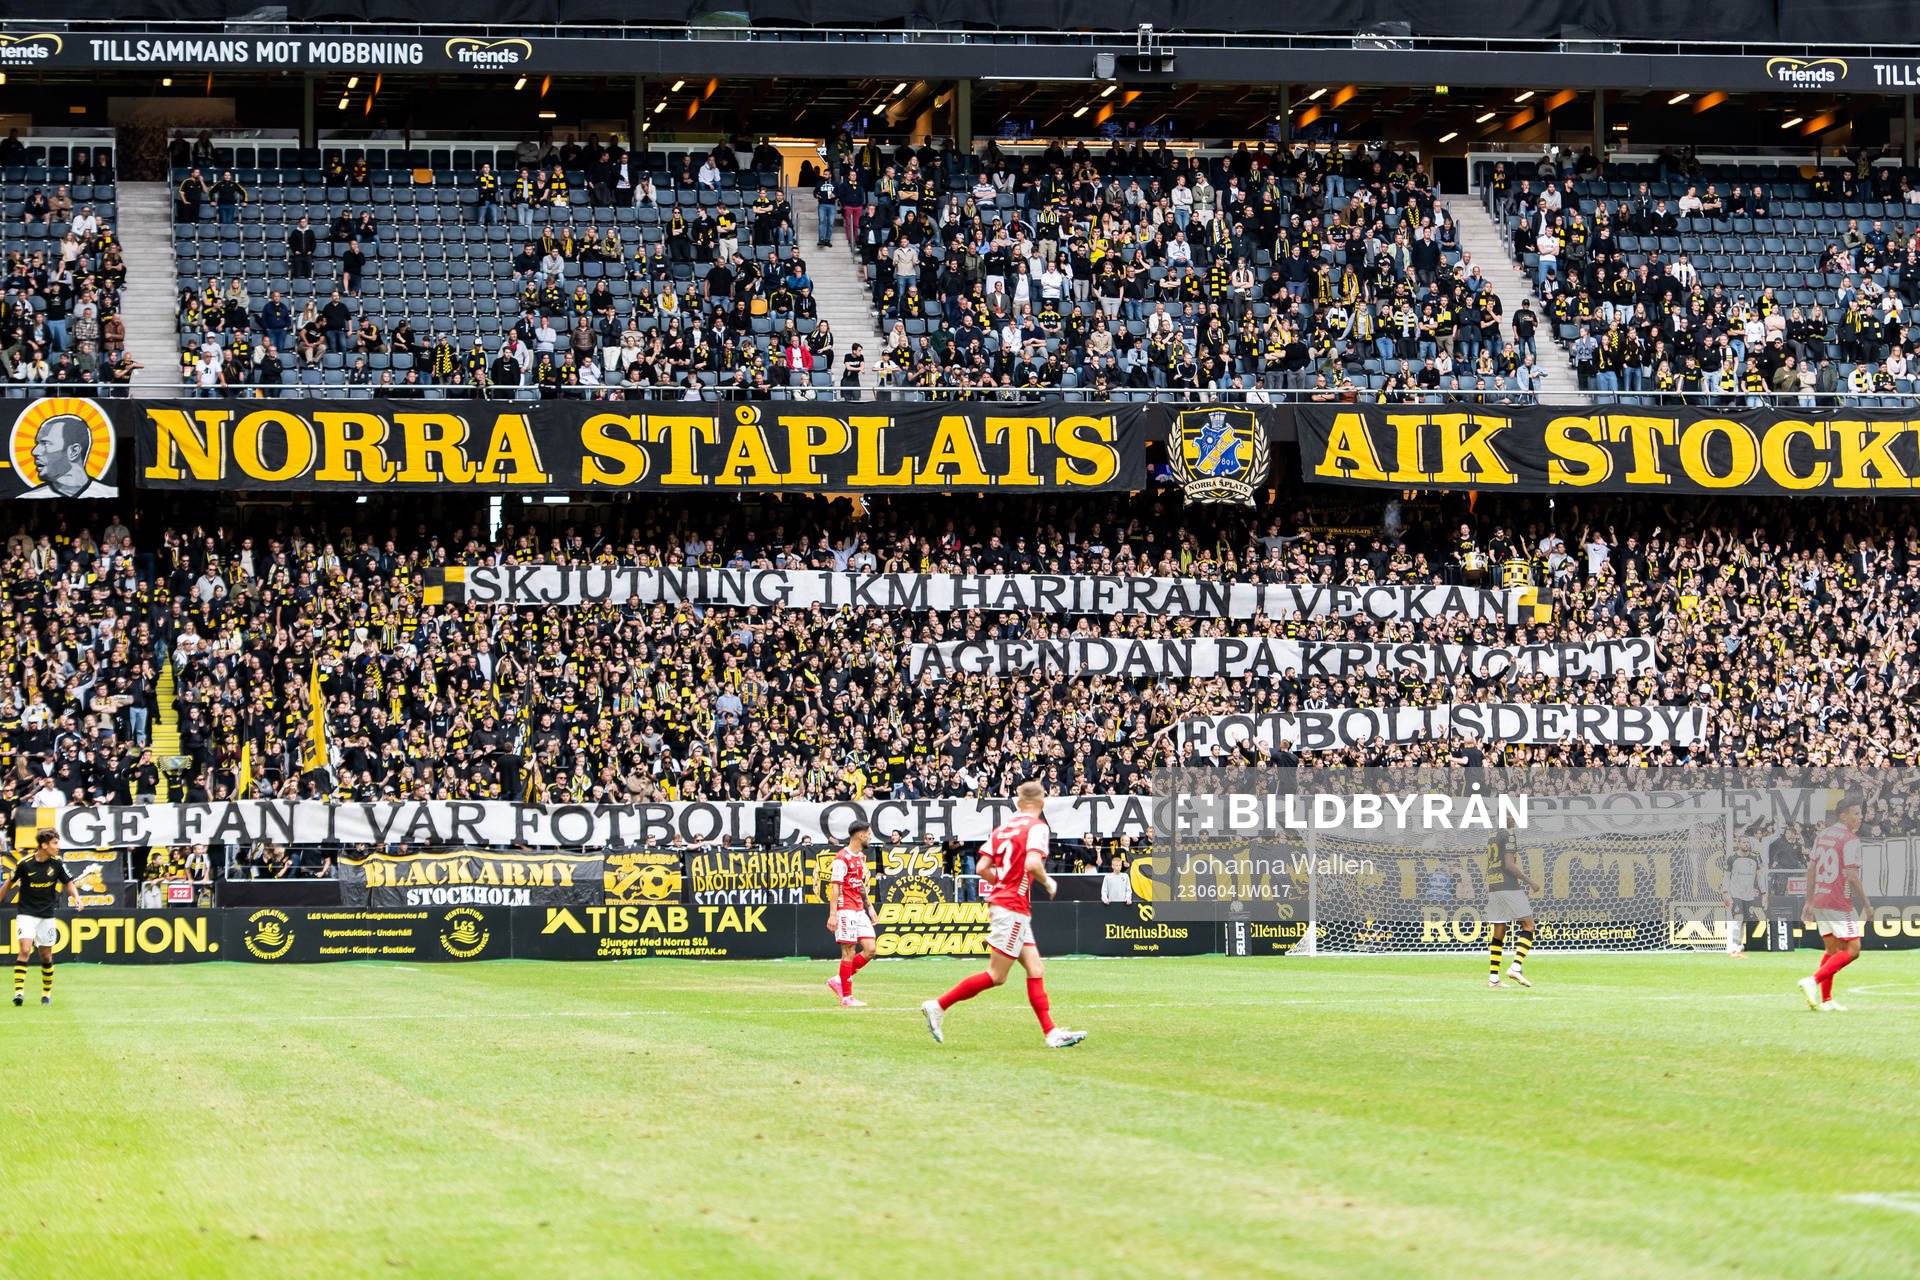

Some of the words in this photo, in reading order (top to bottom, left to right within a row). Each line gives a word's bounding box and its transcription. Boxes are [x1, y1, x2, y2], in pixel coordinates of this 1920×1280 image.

[89, 40, 249, 64] TILLSAMMANS
[256, 41, 301, 64] MOT
[308, 41, 423, 65] MOBBNING
[457, 46, 519, 64] friends
[1777, 66, 1836, 82] friends
[1873, 64, 1920, 86] TILL
[145, 409, 552, 485] NORRA
[581, 405, 1120, 487] STÅPLATS
[1314, 412, 1518, 484] AIK
[1545, 414, 1920, 490] STOCK
[1188, 480, 1217, 492] NORRA
[469, 565, 794, 607] SKJUTNING
[951, 573, 1236, 619] HÄRIFRÅN
[1250, 583, 1269, 617] I
[1286, 583, 1513, 624] VECKAN
[914, 638, 1196, 678] AGENDAN
[60, 804, 151, 848] GE
[172, 800, 301, 847] FAN
[322, 801, 342, 848] I
[361, 799, 490, 846] VÅR
[820, 800, 957, 845] OCH
[975, 796, 1057, 841] T
[691, 850, 802, 879] ALLMÄNNA
[884, 845, 942, 878] 515
[364, 858, 473, 888] BLACK
[474, 861, 577, 888] ARMY
[172, 889, 189, 899] 122
[406, 885, 531, 907] STOCKHOLM
[694, 888, 804, 906] STOCKHOLM
[886, 884, 897, 903] AIK
[248, 908, 289, 924] VENTILATION
[322, 912, 355, 920] Ventilation
[362, 911, 417, 922] Fastighetsservice
[443, 907, 485, 922] VENTILATION
[586, 906, 689, 934] TISAB
[698, 905, 768, 934] TAK
[258, 920, 281, 934] L&S
[323, 928, 372, 938] Nyproduktion
[377, 928, 413, 937] Underhåll
[453, 919, 476, 933] L&S
[1105, 922, 1189, 940] ElléniusBuss
[319, 946, 348, 955] Industri
[352, 946, 378, 955] Kontor
[382, 945, 417, 955] Bostäder
[600, 938, 638, 949] Sjunger
[640, 938, 661, 947] Med
[663, 938, 691, 947] Norra
[692, 936, 709, 947] Stå
[633, 947, 648, 956] 120
[655, 947, 727, 956] www.TISABTAK.se
